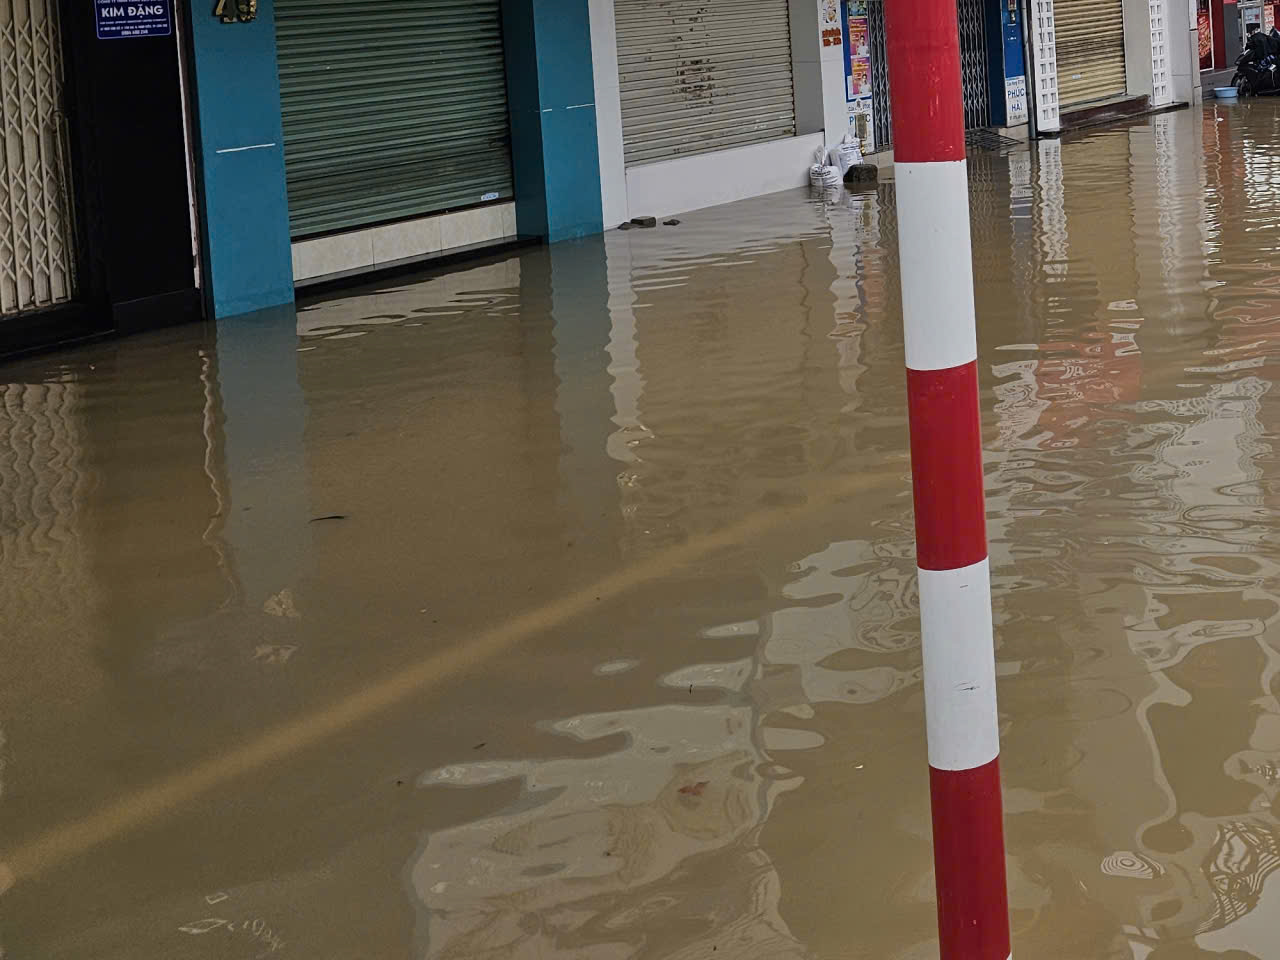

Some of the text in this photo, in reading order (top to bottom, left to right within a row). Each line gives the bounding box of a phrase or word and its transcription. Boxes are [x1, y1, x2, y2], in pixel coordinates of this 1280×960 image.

[101, 3, 164, 19] KIM ĐẶNG
[1008, 86, 1025, 99] PHÚC
[1011, 100, 1023, 112] HẢI
